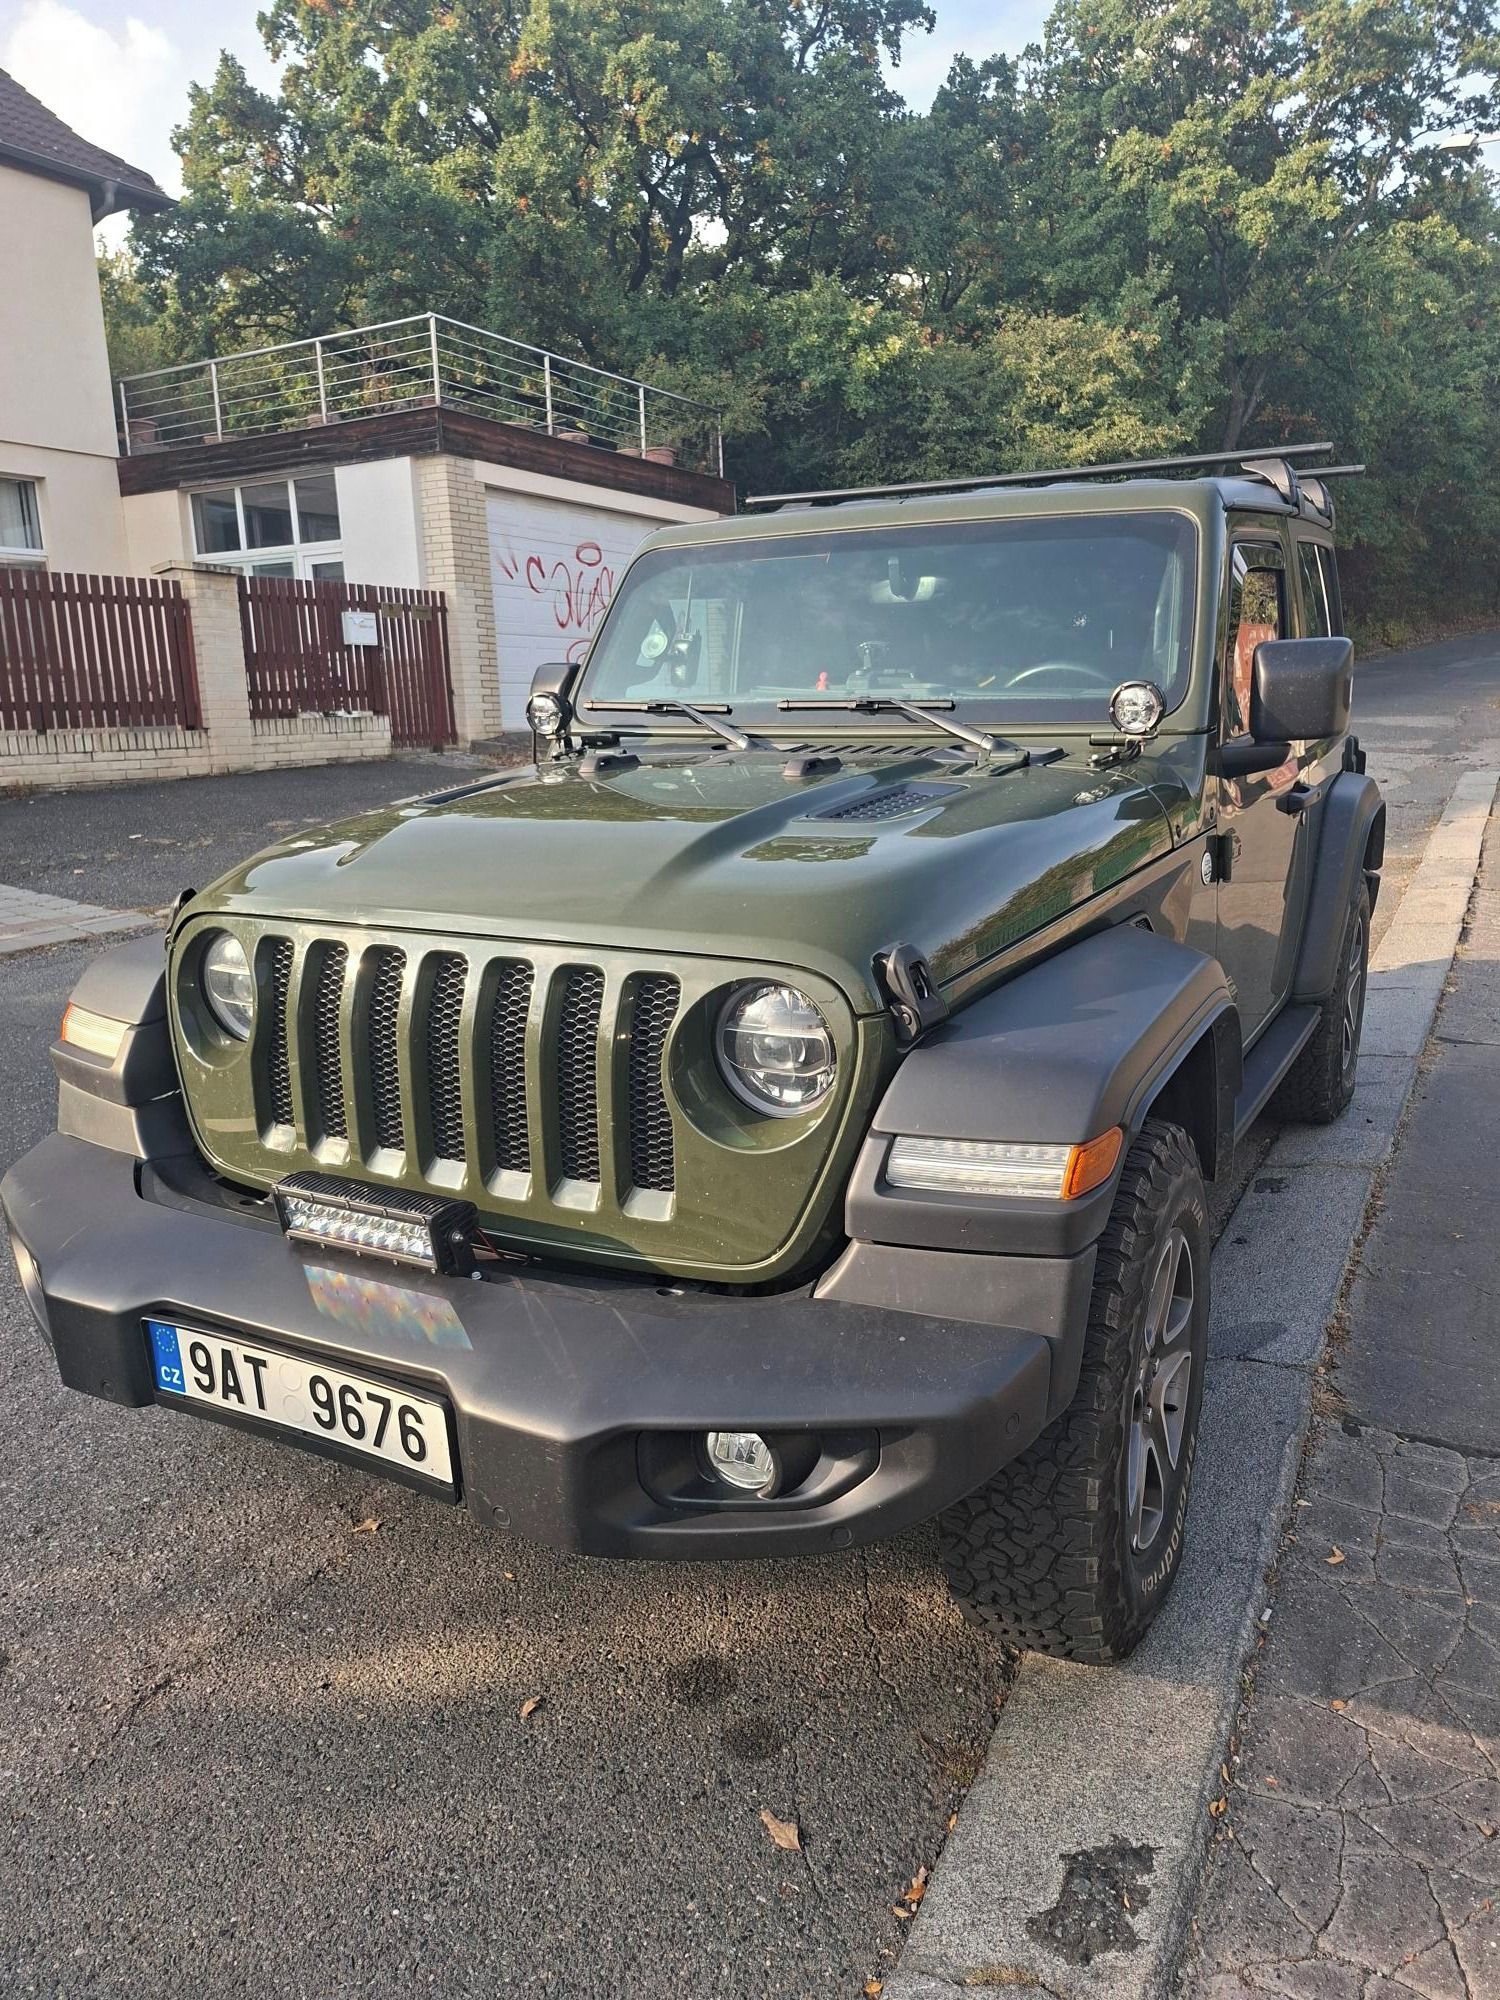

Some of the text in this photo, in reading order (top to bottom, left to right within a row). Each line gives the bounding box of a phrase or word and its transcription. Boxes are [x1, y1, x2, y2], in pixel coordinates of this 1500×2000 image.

[160, 1366, 182, 1385] CZ
[190, 1341, 427, 1462] 9AT 9676
